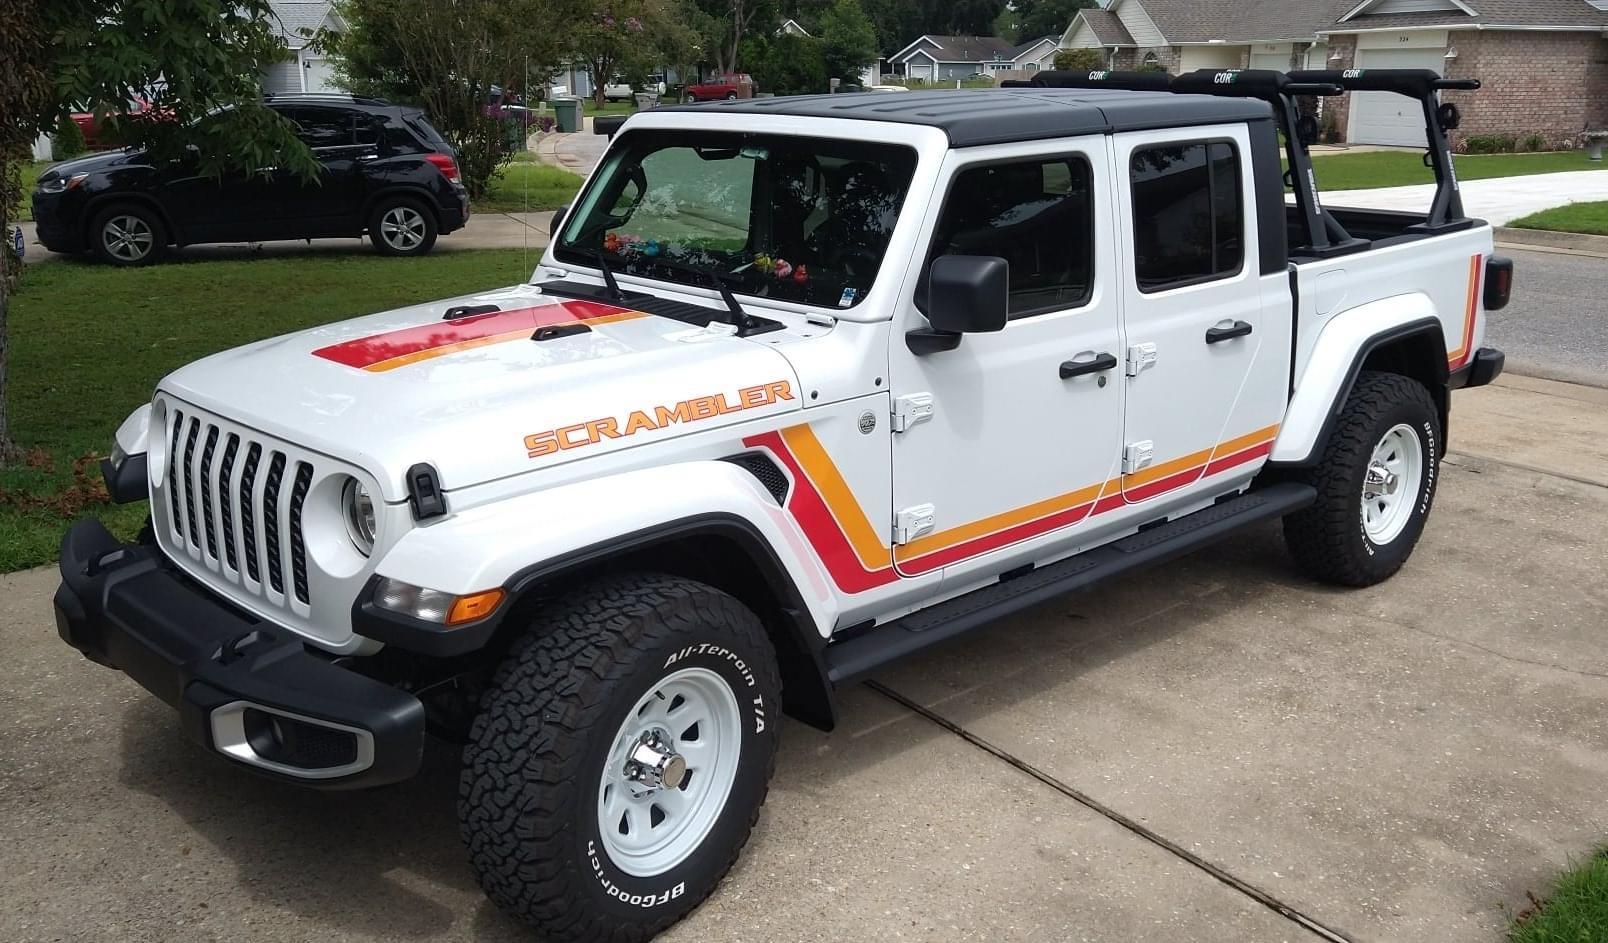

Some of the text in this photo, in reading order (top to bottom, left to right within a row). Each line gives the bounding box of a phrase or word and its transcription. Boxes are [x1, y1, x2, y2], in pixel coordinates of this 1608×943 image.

[523, 380, 795, 458] SCRAMBLER
[1420, 421, 1435, 514] BFGoodrich
[663, 643, 765, 734] All-Terrain T/A
[587, 840, 685, 908] BFGoodrich
